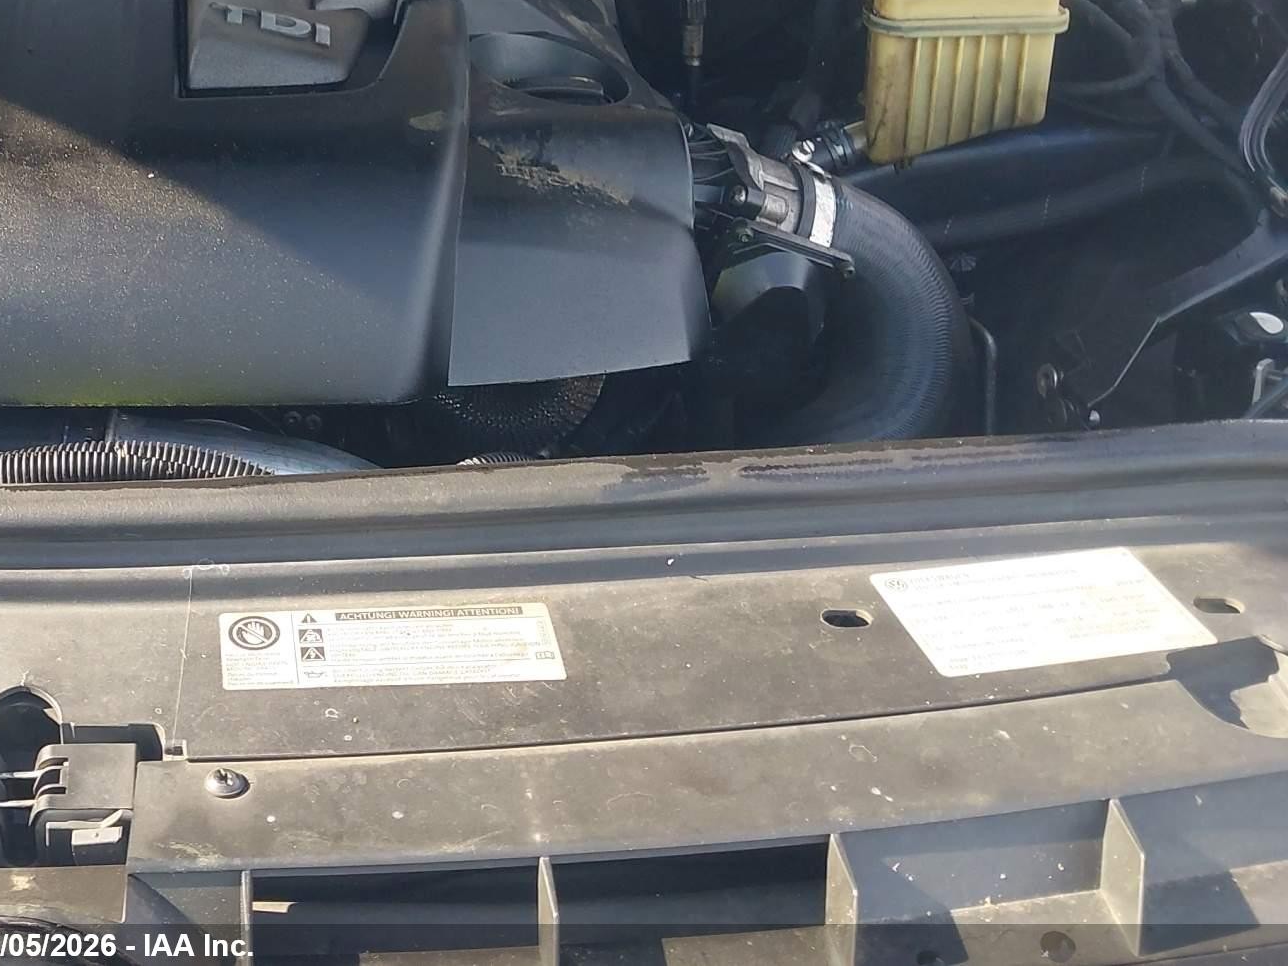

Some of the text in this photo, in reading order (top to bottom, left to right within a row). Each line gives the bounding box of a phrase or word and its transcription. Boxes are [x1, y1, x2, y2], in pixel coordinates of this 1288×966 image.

[209, 2, 331, 47] TDI
[340, 608, 519, 620] ACHTUNG! WARNING! ATTENTION!
